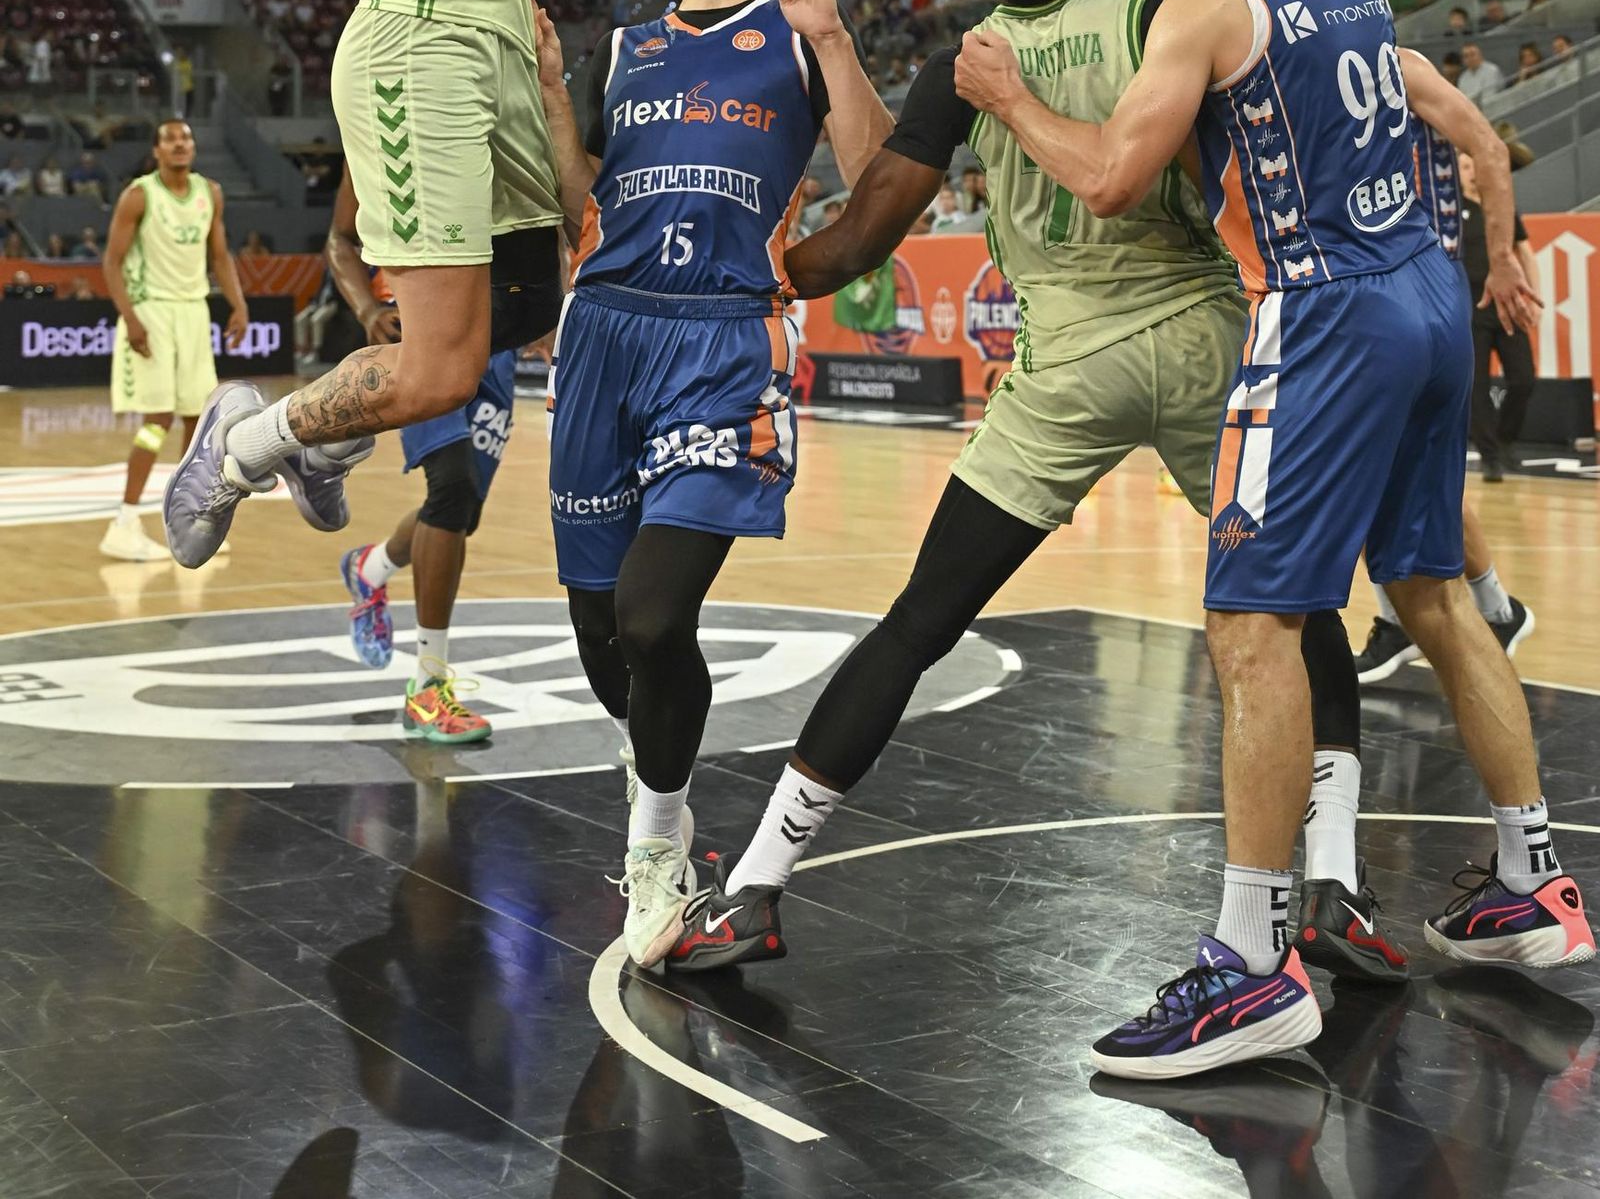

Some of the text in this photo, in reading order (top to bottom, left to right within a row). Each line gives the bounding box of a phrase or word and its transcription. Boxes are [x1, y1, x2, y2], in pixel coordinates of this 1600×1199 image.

[612, 92, 777, 136] Flexi car
[1337, 42, 1408, 149] 99
[616, 166, 760, 212] FUENLABRADA
[174, 226, 201, 245] 32
[660, 222, 695, 267] 15
[473, 402, 513, 440] PA
